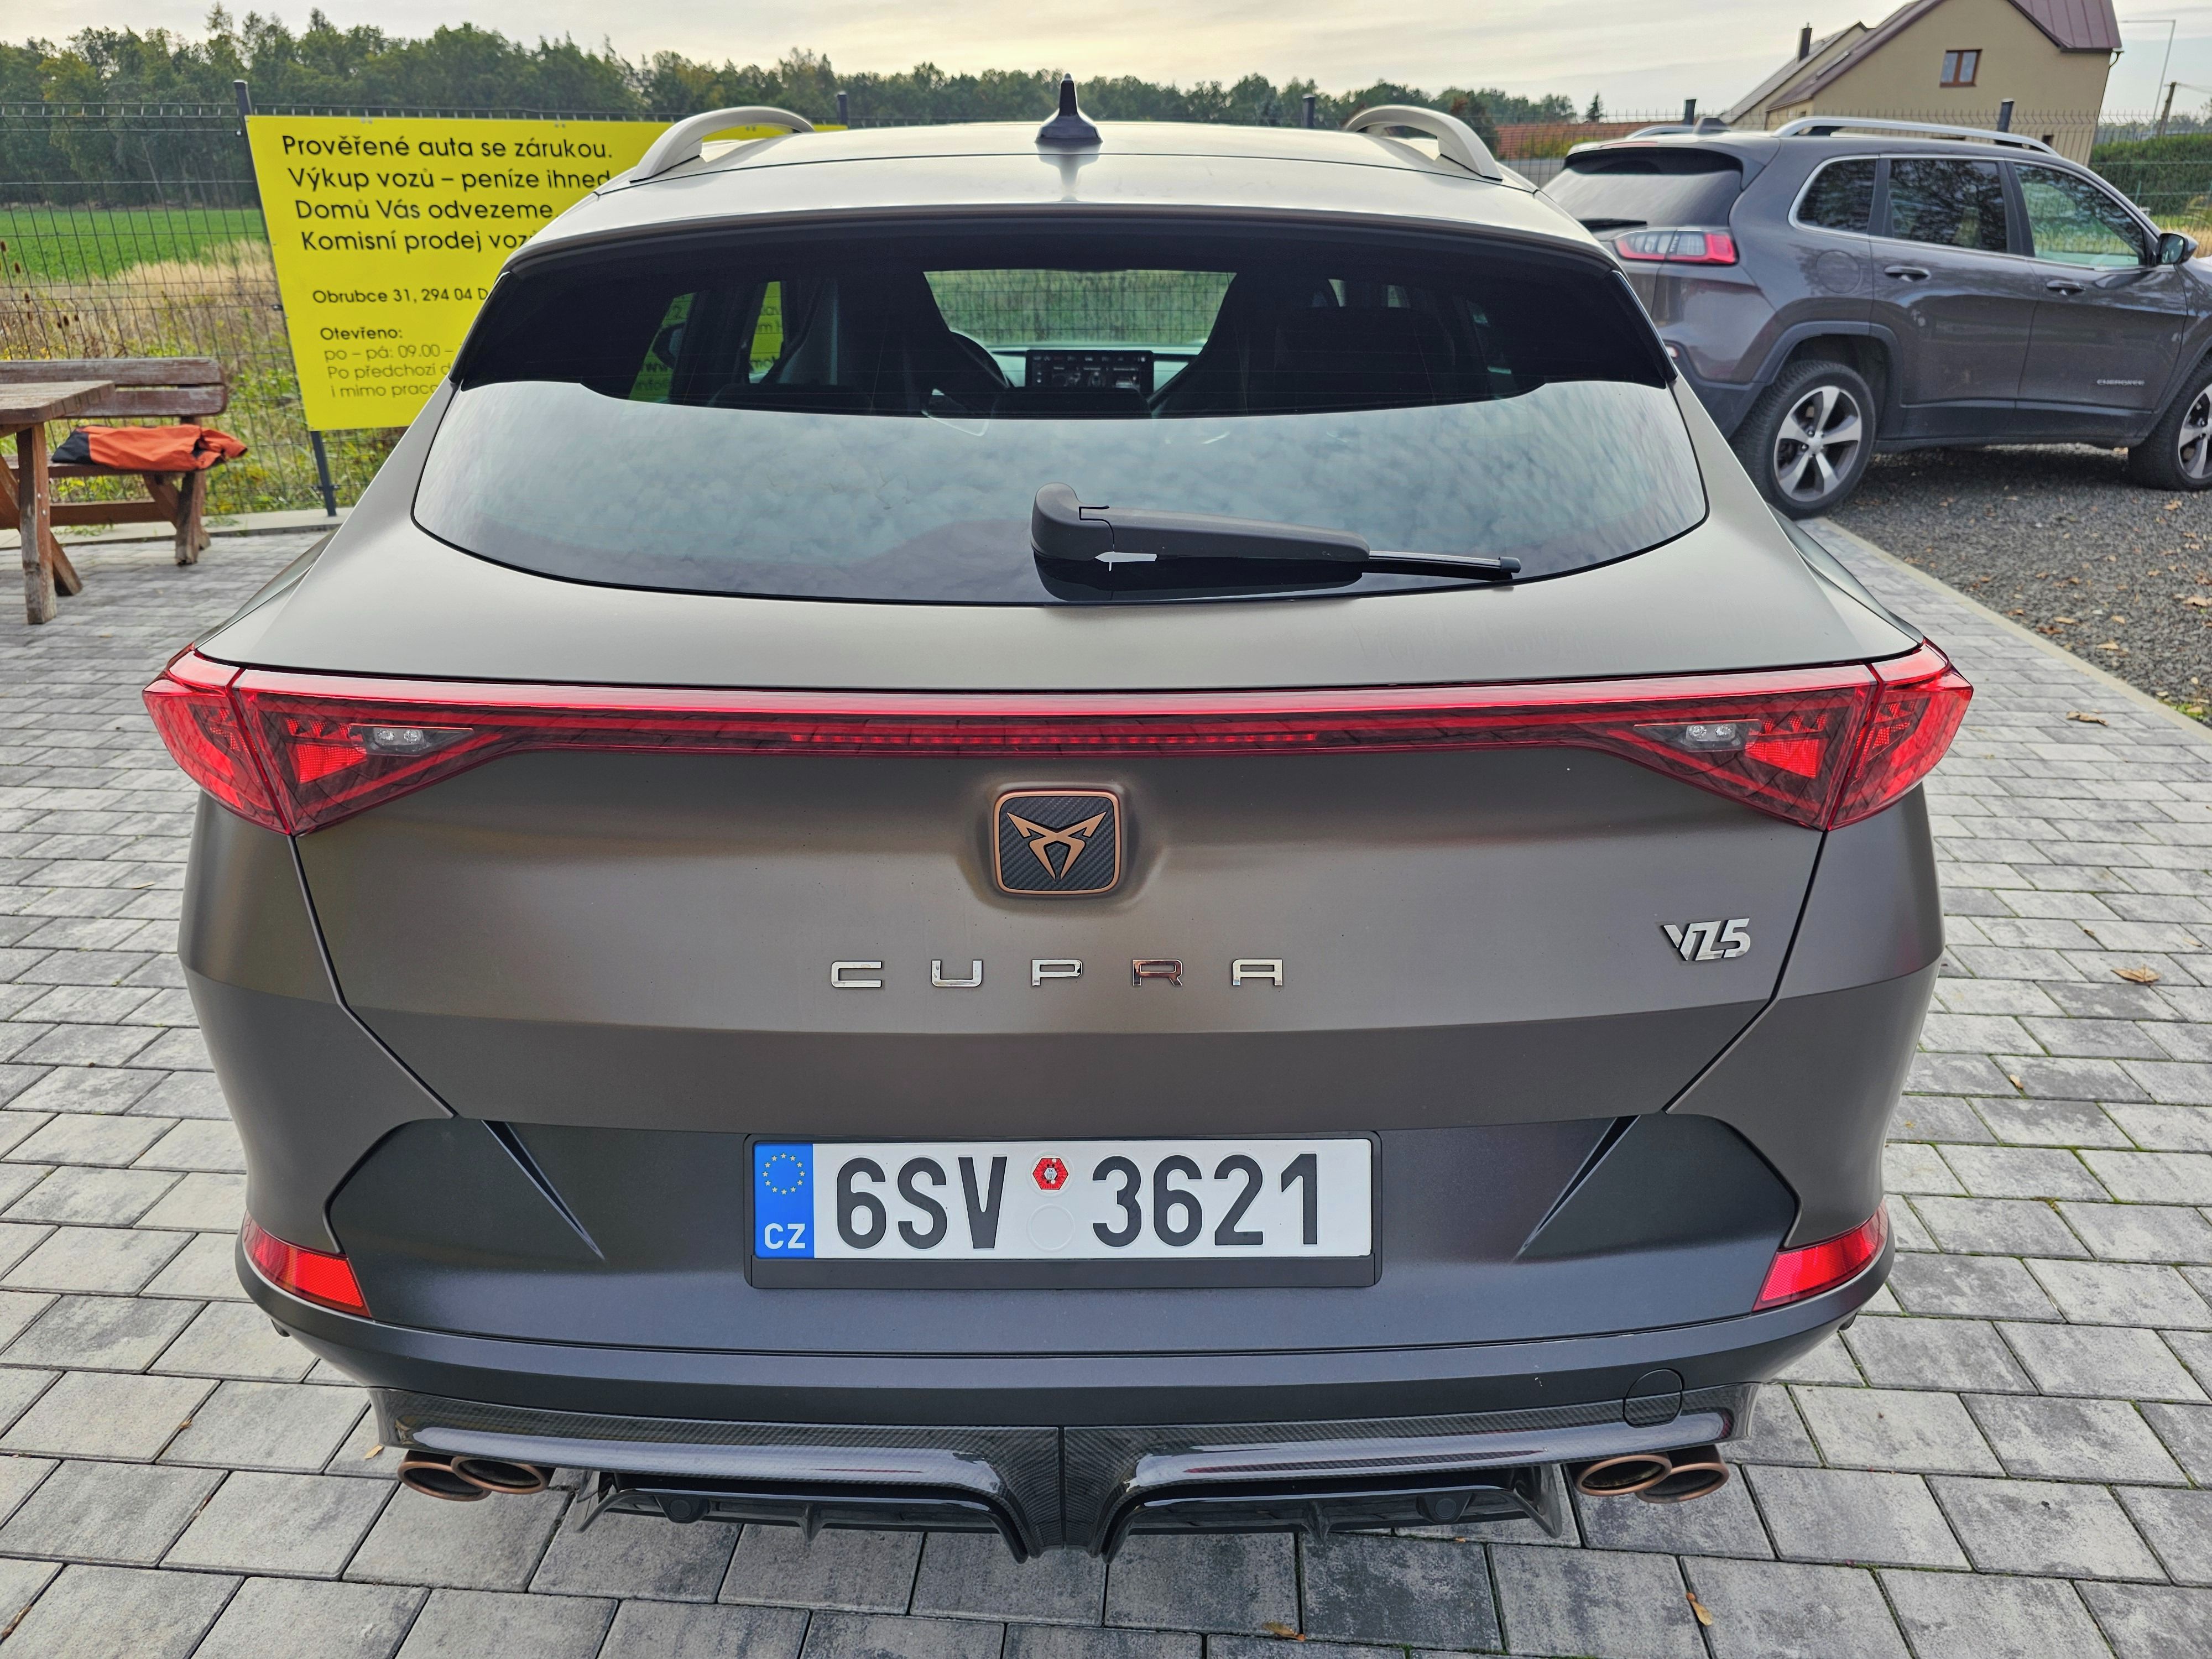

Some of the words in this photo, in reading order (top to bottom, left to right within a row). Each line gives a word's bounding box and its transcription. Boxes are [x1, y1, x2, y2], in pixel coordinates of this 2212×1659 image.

[282, 135, 409, 156] Prověřené
[419, 138, 473, 156] auta
[481, 143, 506, 157] se
[514, 138, 612, 158] zárukou.
[288, 167, 369, 192] Výkup
[377, 169, 434, 187] vozů
[462, 169, 539, 192] peníze
[295, 200, 369, 219] Domů
[376, 199, 420, 218] Vás
[301, 230, 396, 250] Komisní
[404, 231, 481, 254] prodej
[488, 230, 533, 248] voz
[312, 290, 388, 303] Obrubce
[393, 289, 416, 303] 31,
[421, 289, 449, 301] 294
[454, 288, 472, 301] 04
[320, 327, 402, 340] Otevřeno:
[324, 349, 347, 363] po
[398, 344, 440, 358] 09.00
[327, 366, 349, 379] Po
[354, 363, 436, 380] předchozí
[340, 384, 386, 398] mimo
[1660, 918, 1751, 961] VZ5
[831, 958, 1283, 988] CUPRA
[836, 1155, 1007, 1250] 6SV
[1092, 1153, 1318, 1248] 3621
[764, 1223, 806, 1249] CZ
